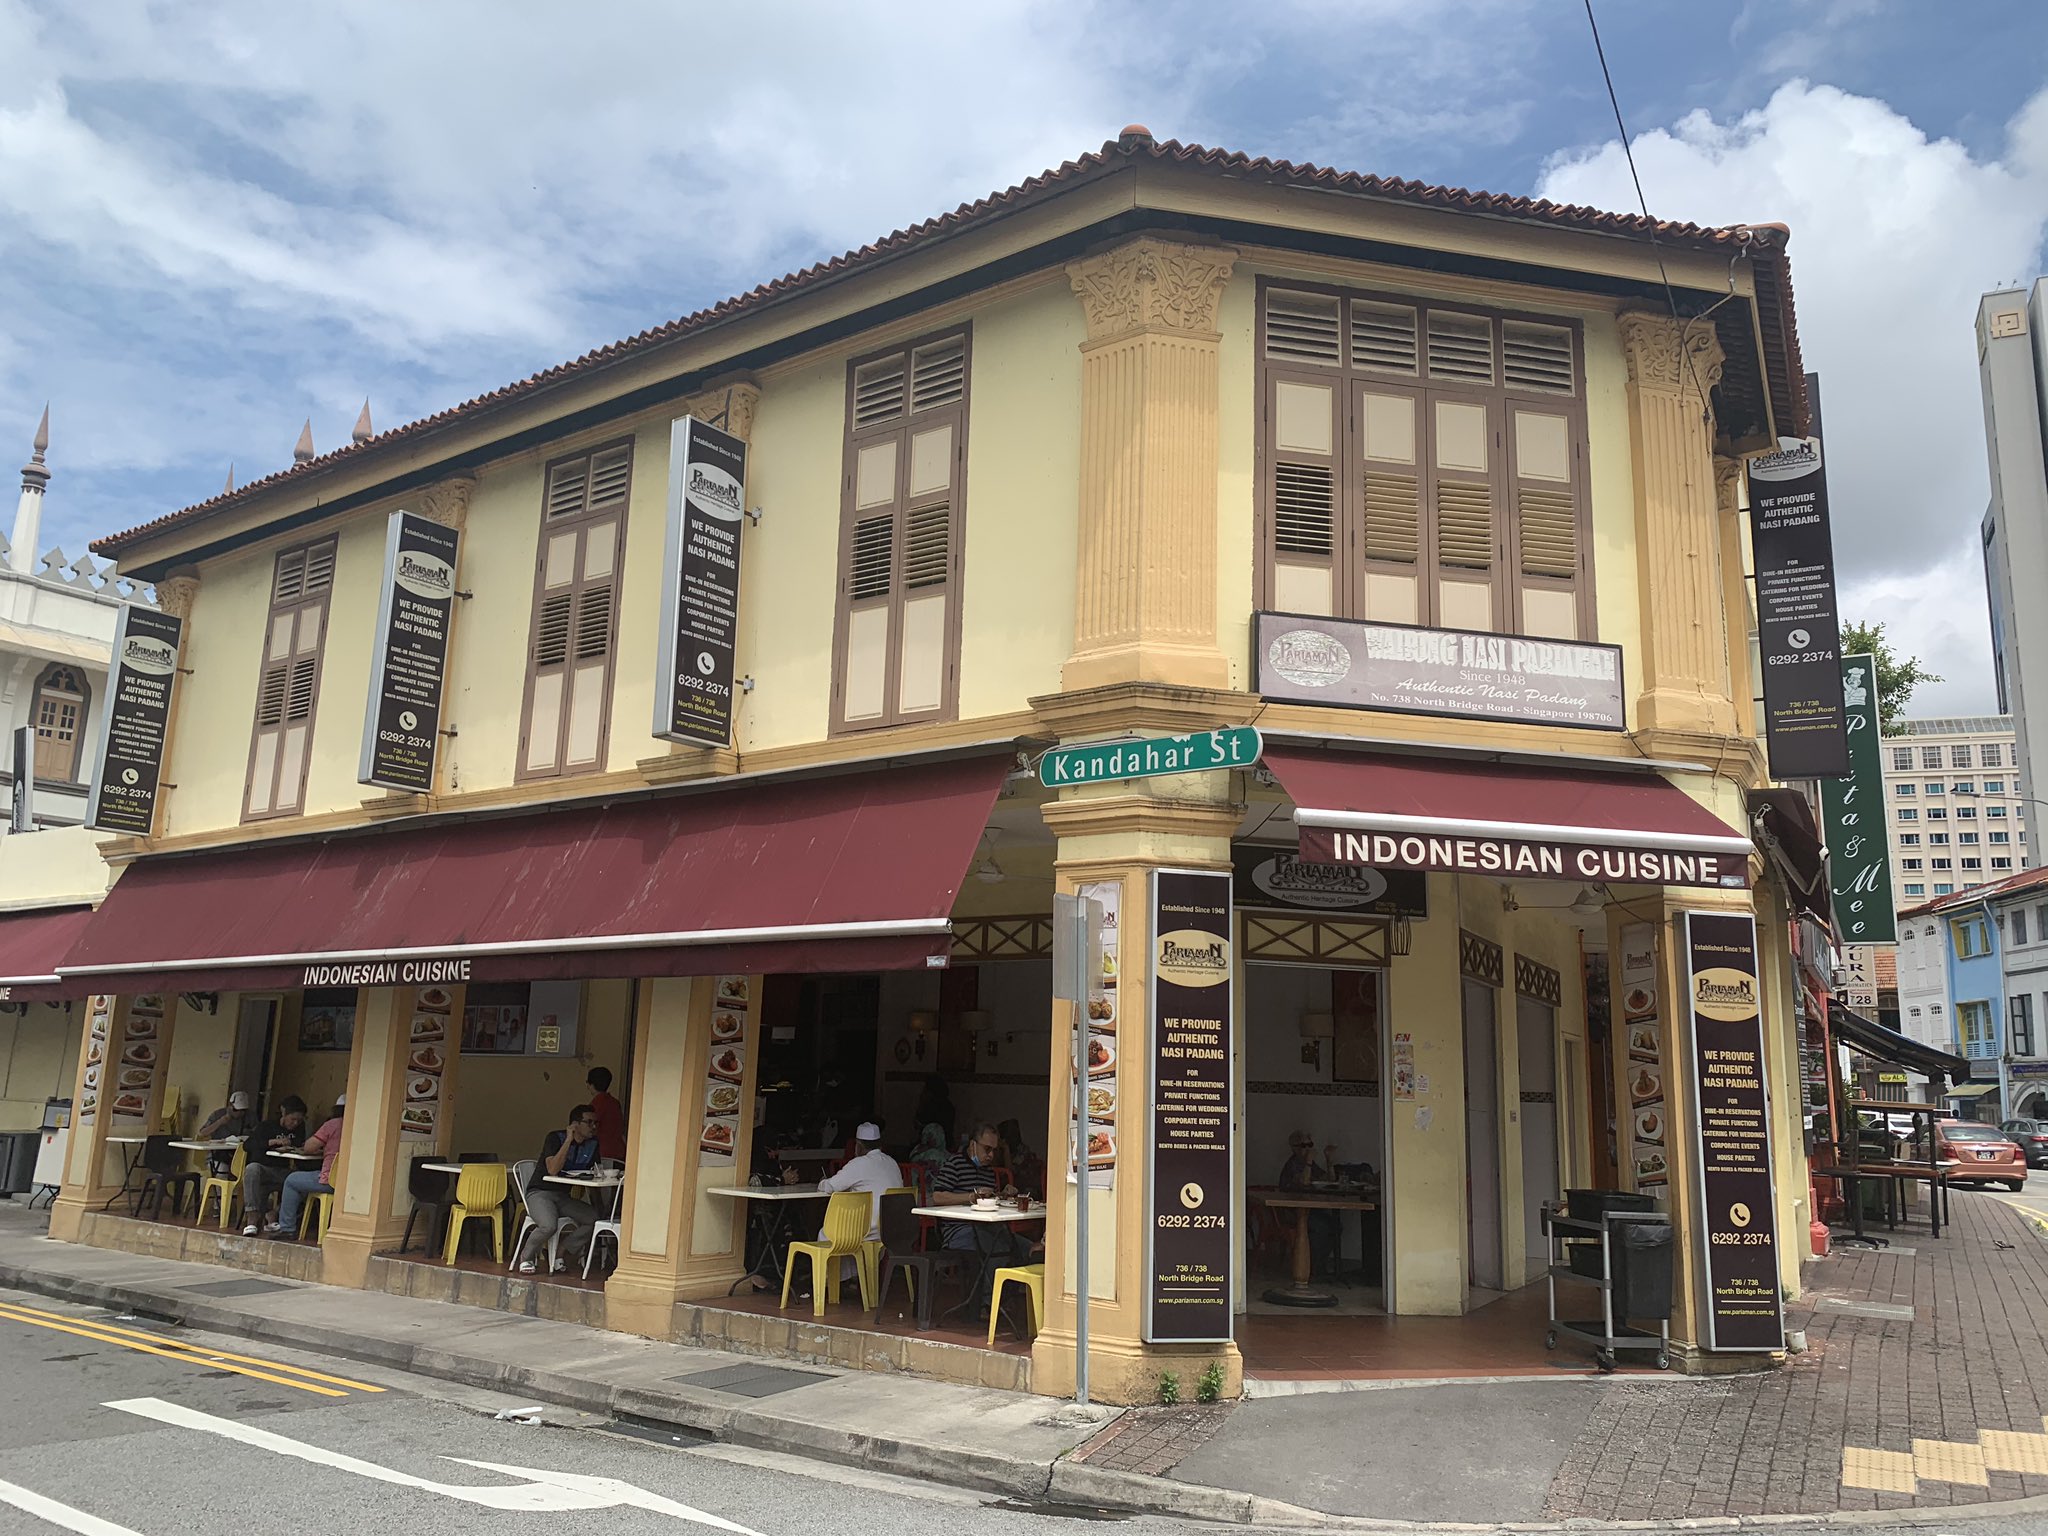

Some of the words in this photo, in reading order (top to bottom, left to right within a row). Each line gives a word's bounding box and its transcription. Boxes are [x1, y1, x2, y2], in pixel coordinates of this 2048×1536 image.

[1760, 498, 1774, 508] WE
[1777, 492, 1815, 505] PROVIDE
[1764, 503, 1813, 518] AUTHENTIC
[1759, 519, 1780, 530] NASI
[1783, 514, 1820, 527] PADANG
[691, 518, 703, 532] WE
[704, 523, 734, 543] PROVIDE
[692, 531, 731, 555] AUTHENTIC
[687, 543, 705, 558] NASI
[707, 550, 735, 569] PADANG
[398, 598, 410, 609] WE
[412, 602, 443, 618] PROVIDE
[399, 609, 439, 628] AUTHENTIC
[394, 619, 412, 632] NASI
[413, 624, 442, 640] PADANG
[1461, 636, 1506, 671] NASI
[1768, 653, 1798, 665] 6292
[1802, 649, 1832, 662] 2374
[123, 675, 135, 684] WE
[136, 677, 165, 690] PROVIDE
[678, 672, 703, 690] 6292
[705, 680, 728, 697] 2374
[1460, 670, 1491, 682] Since
[1497, 673, 1526, 685] 1948
[124, 684, 162, 699] AUTHENTIC
[1395, 677, 1474, 696] Authentic
[1478, 684, 1519, 699] Nasi
[1524, 688, 1588, 710] Padang
[119, 693, 136, 703] NASI
[137, 696, 164, 708] PADANG
[1371, 693, 1389, 702] No.
[1392, 694, 1411, 704] 738
[1414, 696, 1445, 707] North
[1449, 699, 1483, 711] Bridge
[1487, 703, 1513, 713] Road
[1523, 706, 1575, 719] Singapore
[1577, 711, 1613, 722] 198706
[677, 699, 693, 709] North
[694, 703, 712, 715] Bridge
[712, 708, 726, 718] Road
[1794, 707, 1816, 715] Bridge
[379, 729, 405, 744] 6292
[407, 735, 431, 749] 2374
[1054, 744, 1194, 781] Kandahar
[1210, 734, 1241, 763] St
[103, 783, 127, 796] 6292
[128, 787, 152, 799] 2374
[1333, 832, 1562, 874] INDONESIAN
[1576, 848, 1719, 884] CUISINE
[1161, 903, 1193, 912] Established
[1194, 905, 1210, 913] Since
[1211, 906, 1224, 914] 1948
[1694, 943, 1723, 951] Established
[303, 963, 398, 985] INDONESIAN
[402, 960, 471, 982] CUISINE
[1850, 995, 1872, 1004] 728
[1164, 1017, 1178, 1028] WE
[1181, 1018, 1220, 1030] PROVIDE
[1167, 1032, 1217, 1044] AUTHENTIC
[1161, 1046, 1183, 1058] NASI
[1186, 1047, 1223, 1059] PADANG
[1704, 1049, 1717, 1060] WE
[1719, 1050, 1754, 1061] PROVIDE
[1707, 1063, 1753, 1075] AUTHENTIC
[1159, 1079, 1181, 1087] DINE-IN
[1183, 1080, 1224, 1088] RESERVATIONS
[1703, 1076, 1723, 1087] NASI
[1725, 1077, 1758, 1089] PADANG
[1164, 1091, 1187, 1099] PRIVATE
[1188, 1092, 1220, 1100] FUNCTIONS
[1156, 1103, 1184, 1111] CATERING
[1185, 1104, 1196, 1112] FOR
[1198, 1104, 1227, 1113] WEDDINGS
[1163, 1116, 1197, 1124] CORPORATE
[1198, 1117, 1220, 1125] EVENTS
[1170, 1129, 1189, 1137] HOUSE
[1190, 1130, 1213, 1138] PARTIES
[1710, 1141, 1739, 1149] CORPORATE
[1716, 1153, 1733, 1161] HOUSE
[1157, 1214, 1189, 1227] 6292
[1194, 1215, 1224, 1228] 2374
[1711, 1232, 1740, 1244] 6292
[1743, 1232, 1770, 1245] 2374
[1175, 1264, 1188, 1272] 736
[1195, 1264, 1207, 1272] 738
[1158, 1273, 1178, 1281] North
[1180, 1274, 1203, 1283] Bridge
[1205, 1274, 1223, 1282] Road
[1735, 1287, 1756, 1295] Bridge
[1757, 1287, 1773, 1295] Road
